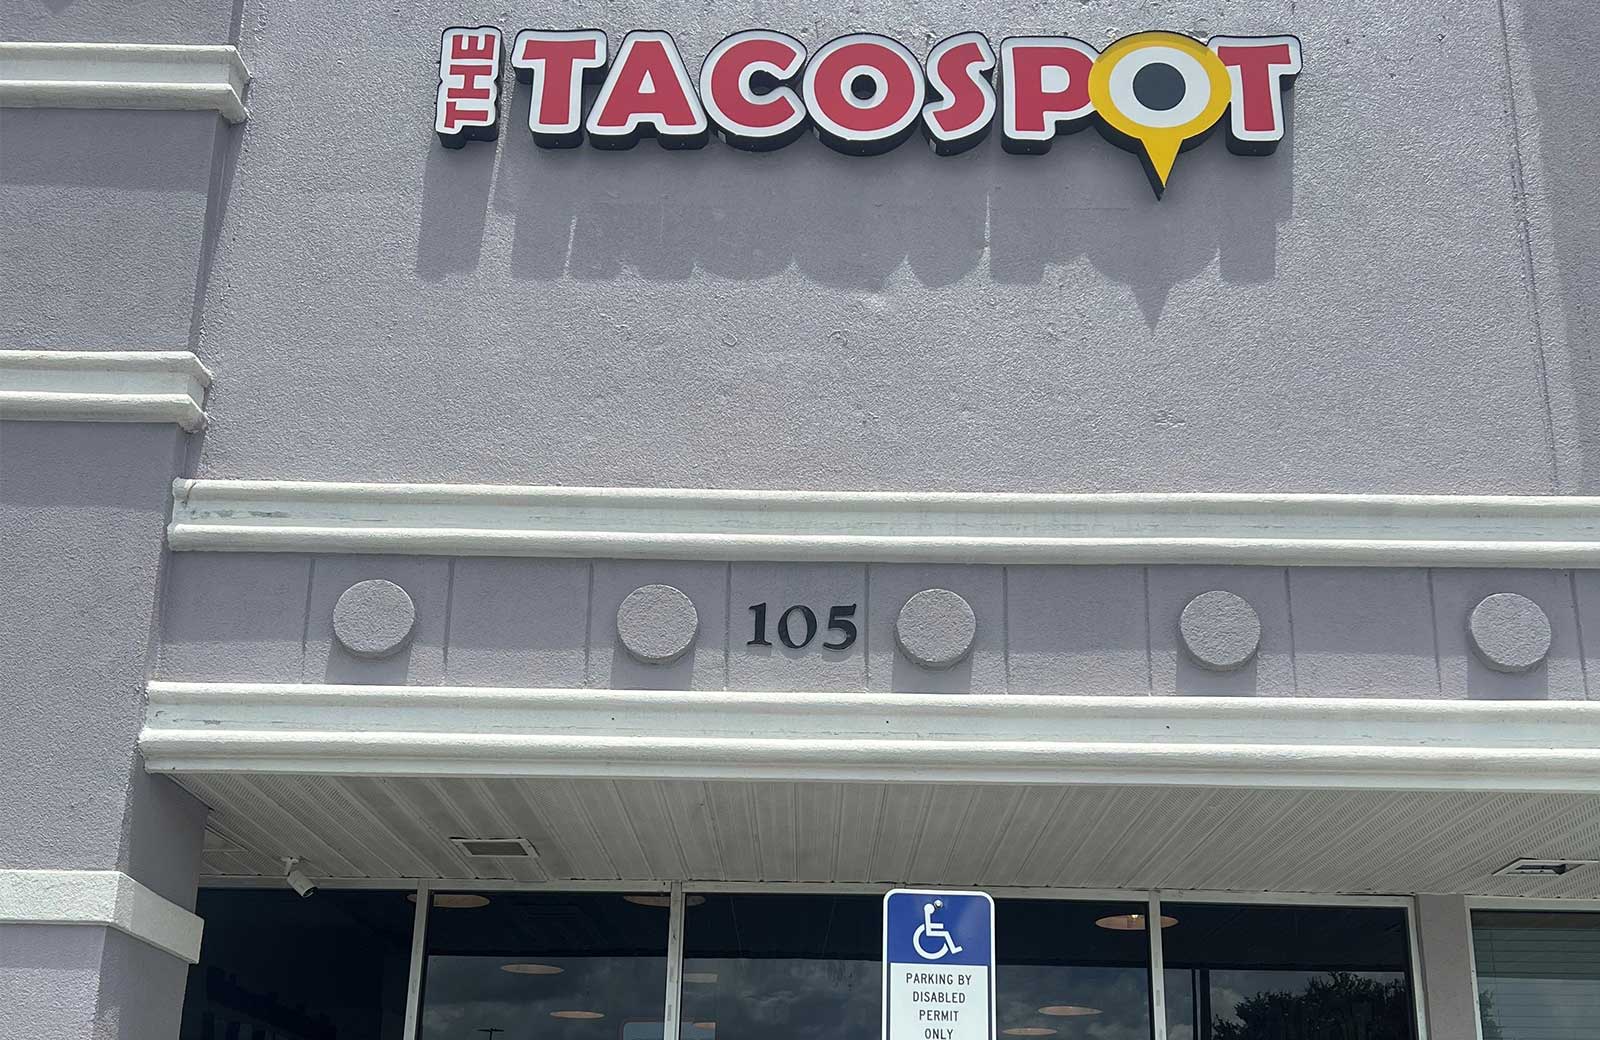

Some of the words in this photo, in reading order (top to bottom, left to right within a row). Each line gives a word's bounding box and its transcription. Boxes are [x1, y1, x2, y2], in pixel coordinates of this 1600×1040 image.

[443, 32, 497, 130] THE
[747, 602, 857, 650] 105
[906, 972, 953, 985] PARKING
[958, 974, 972, 985] BY
[913, 991, 966, 1003] DISABLED
[919, 1010, 959, 1021] PERMIT
[924, 1028, 953, 1040] ONLY
